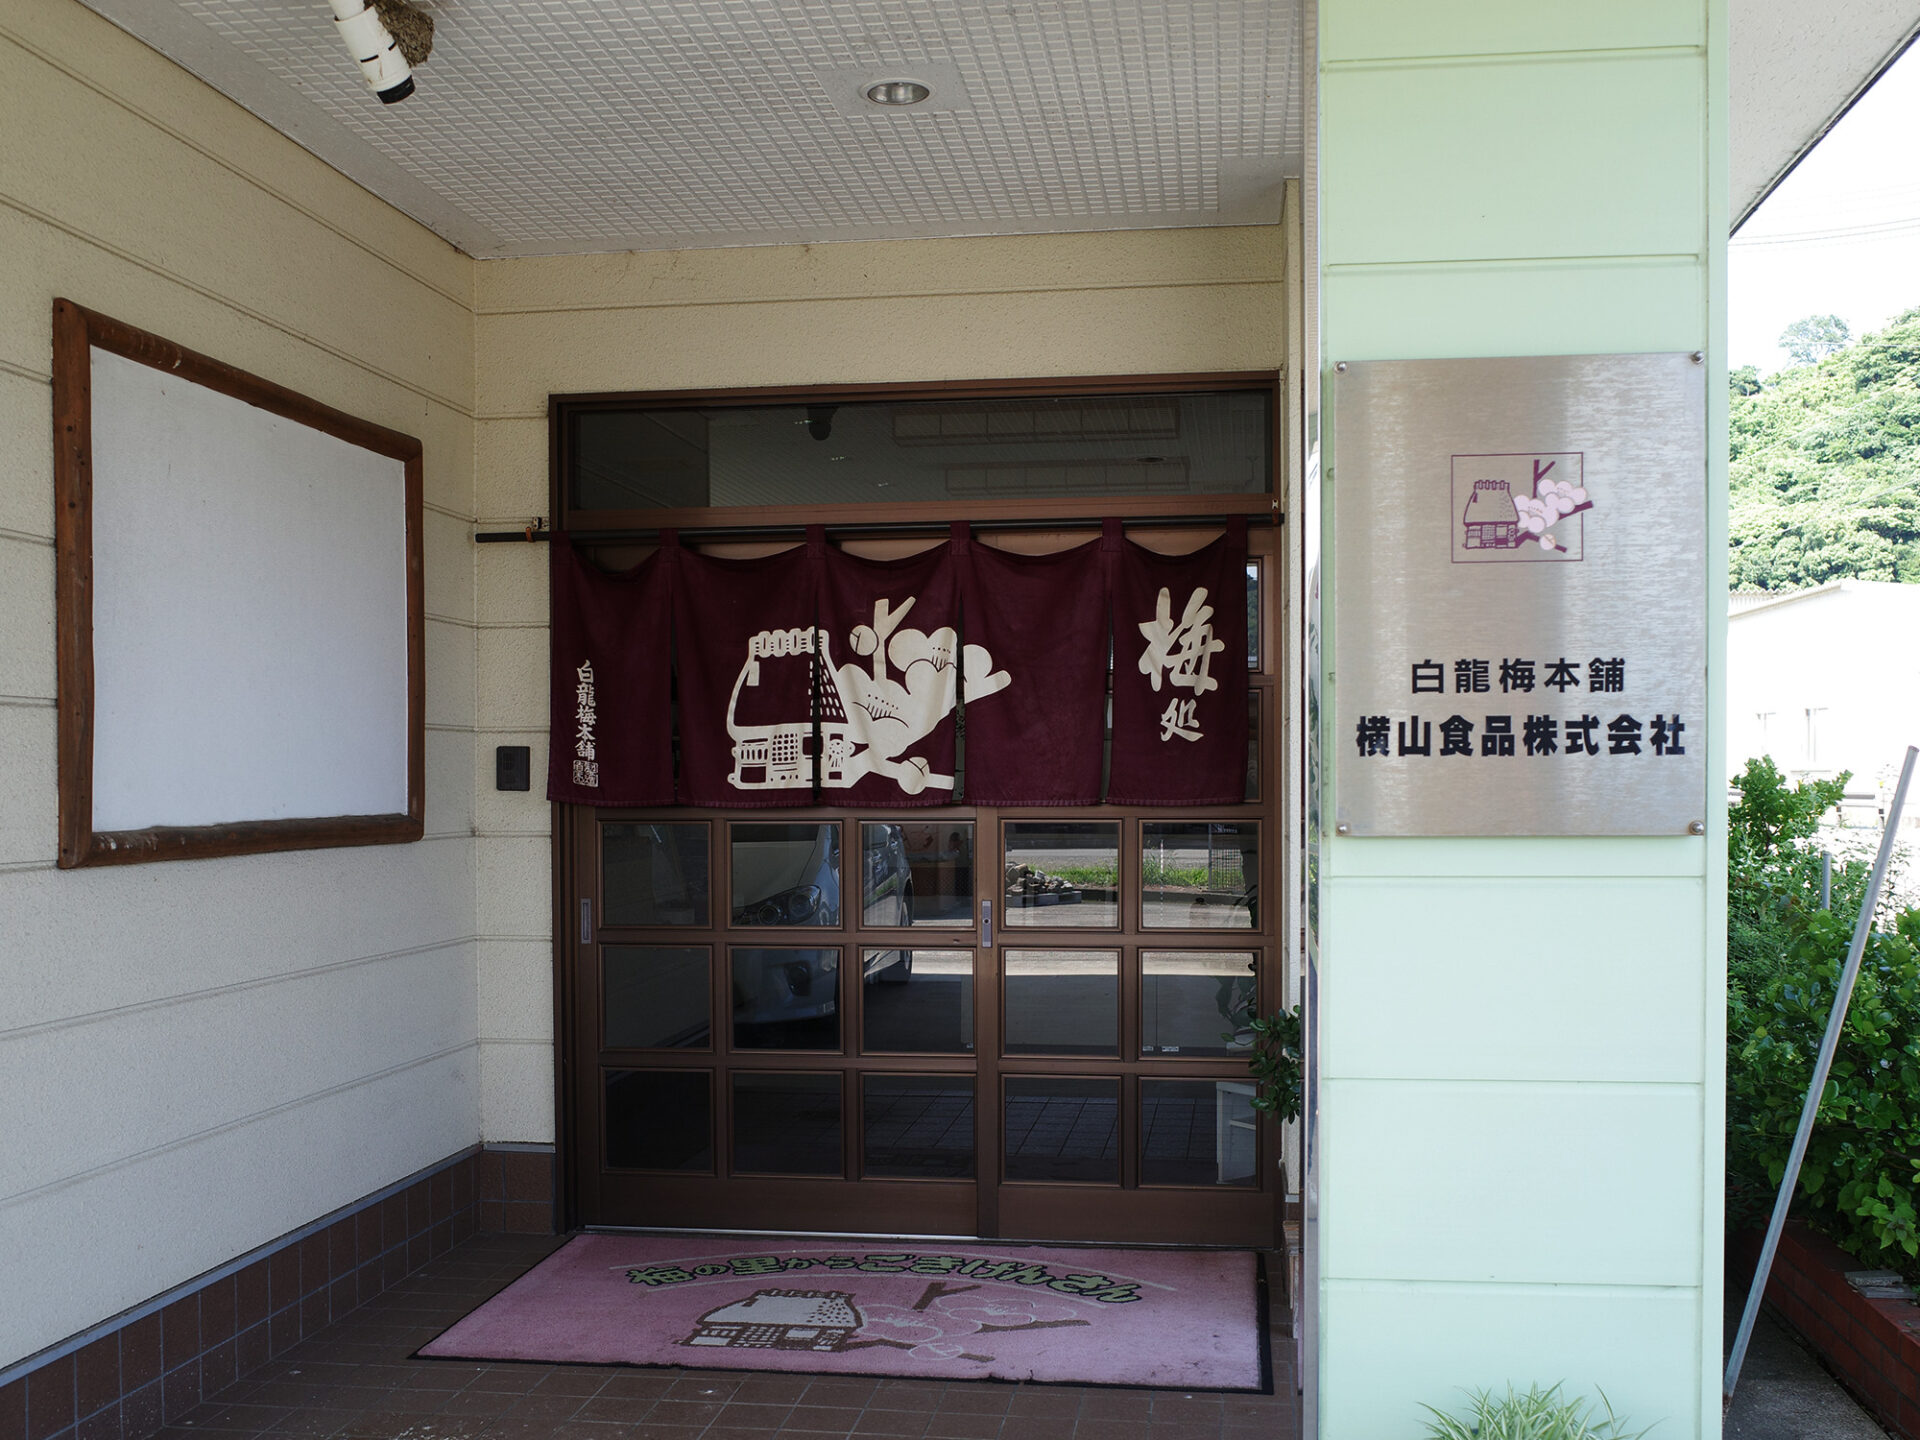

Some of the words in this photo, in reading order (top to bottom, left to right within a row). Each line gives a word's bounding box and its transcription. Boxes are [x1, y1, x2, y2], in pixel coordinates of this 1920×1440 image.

[1411, 657, 1626, 694] 白龍梅本舗
[574, 660, 598, 761] 白龍梅本舗
[1355, 714, 1686, 757] 横山食品株式会社
[625, 1254, 1142, 1304] 梅の里からごきげんさん
